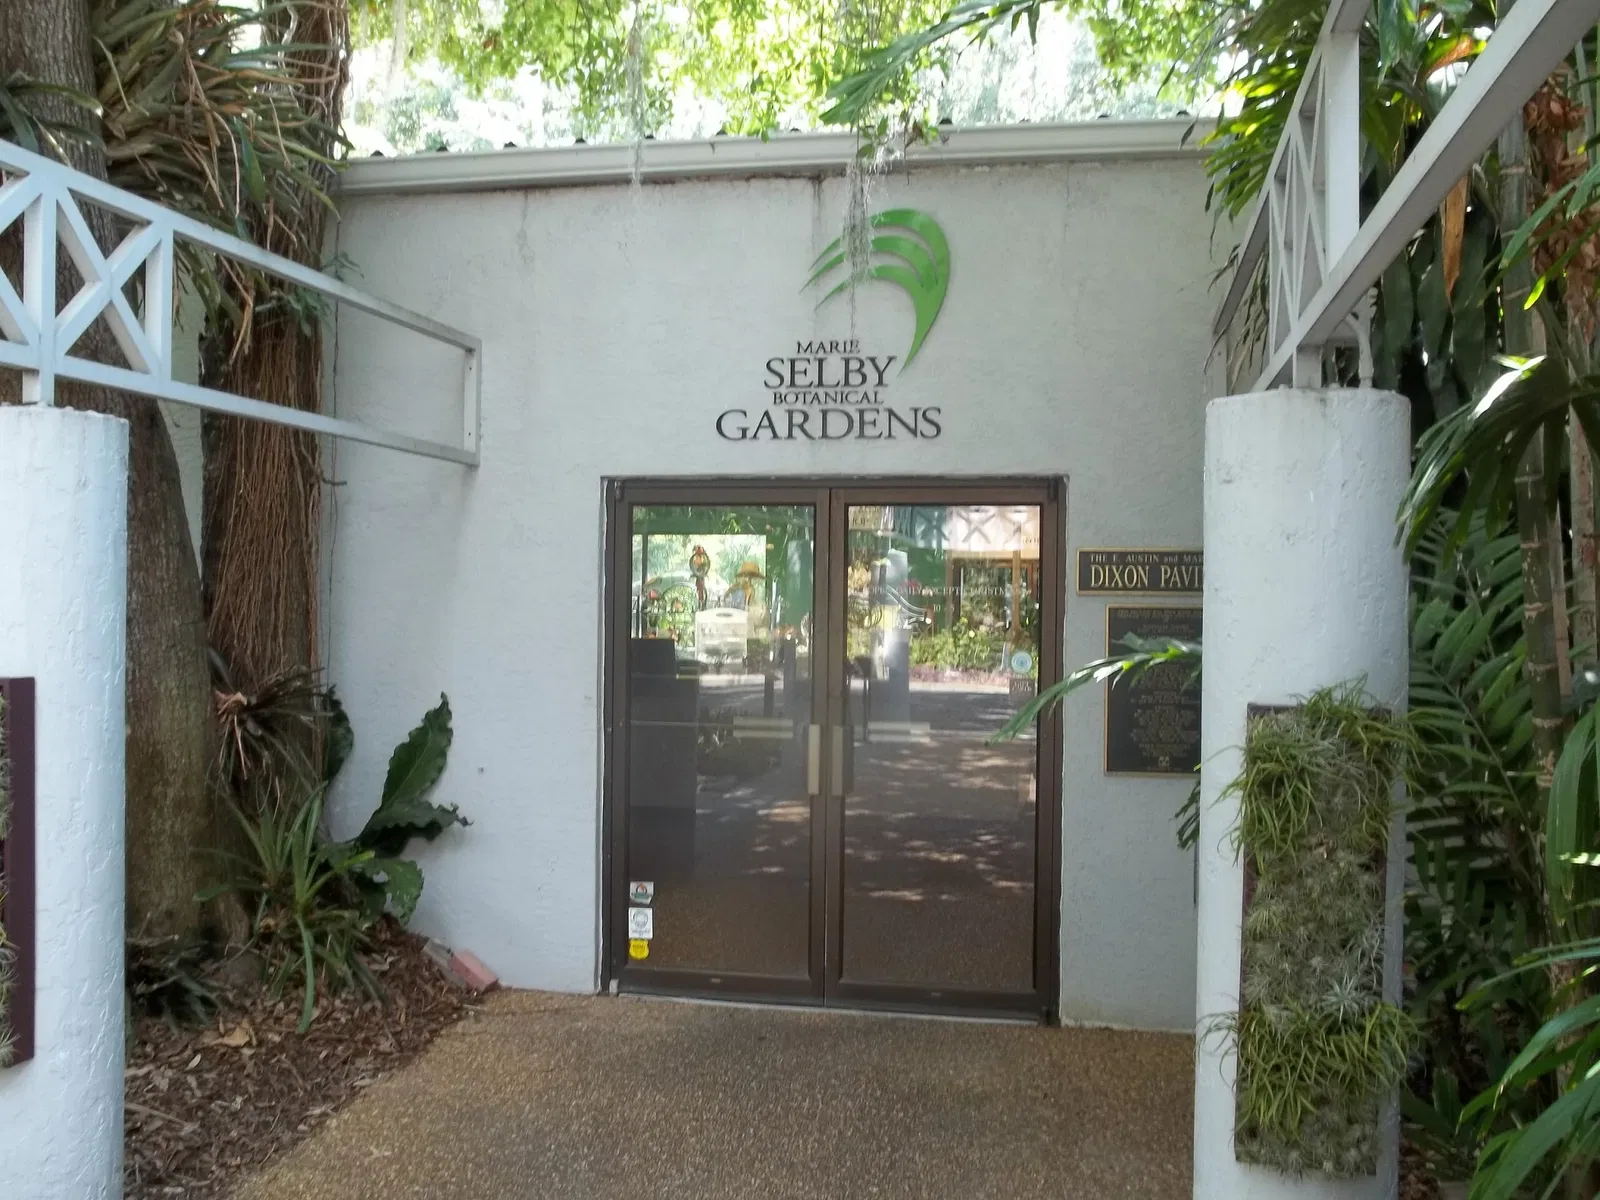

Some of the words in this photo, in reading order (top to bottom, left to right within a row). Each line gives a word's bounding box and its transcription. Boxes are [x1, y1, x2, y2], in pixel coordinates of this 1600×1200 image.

[796, 340, 860, 354] MARIE
[764, 355, 897, 389] SELBY
[773, 391, 884, 405] BOTANICAL
[716, 407, 942, 441] GARDENS
[1126, 554, 1159, 563] AUSTIN
[1091, 565, 1149, 588] DIXON
[1160, 565, 1202, 588] PAVI
